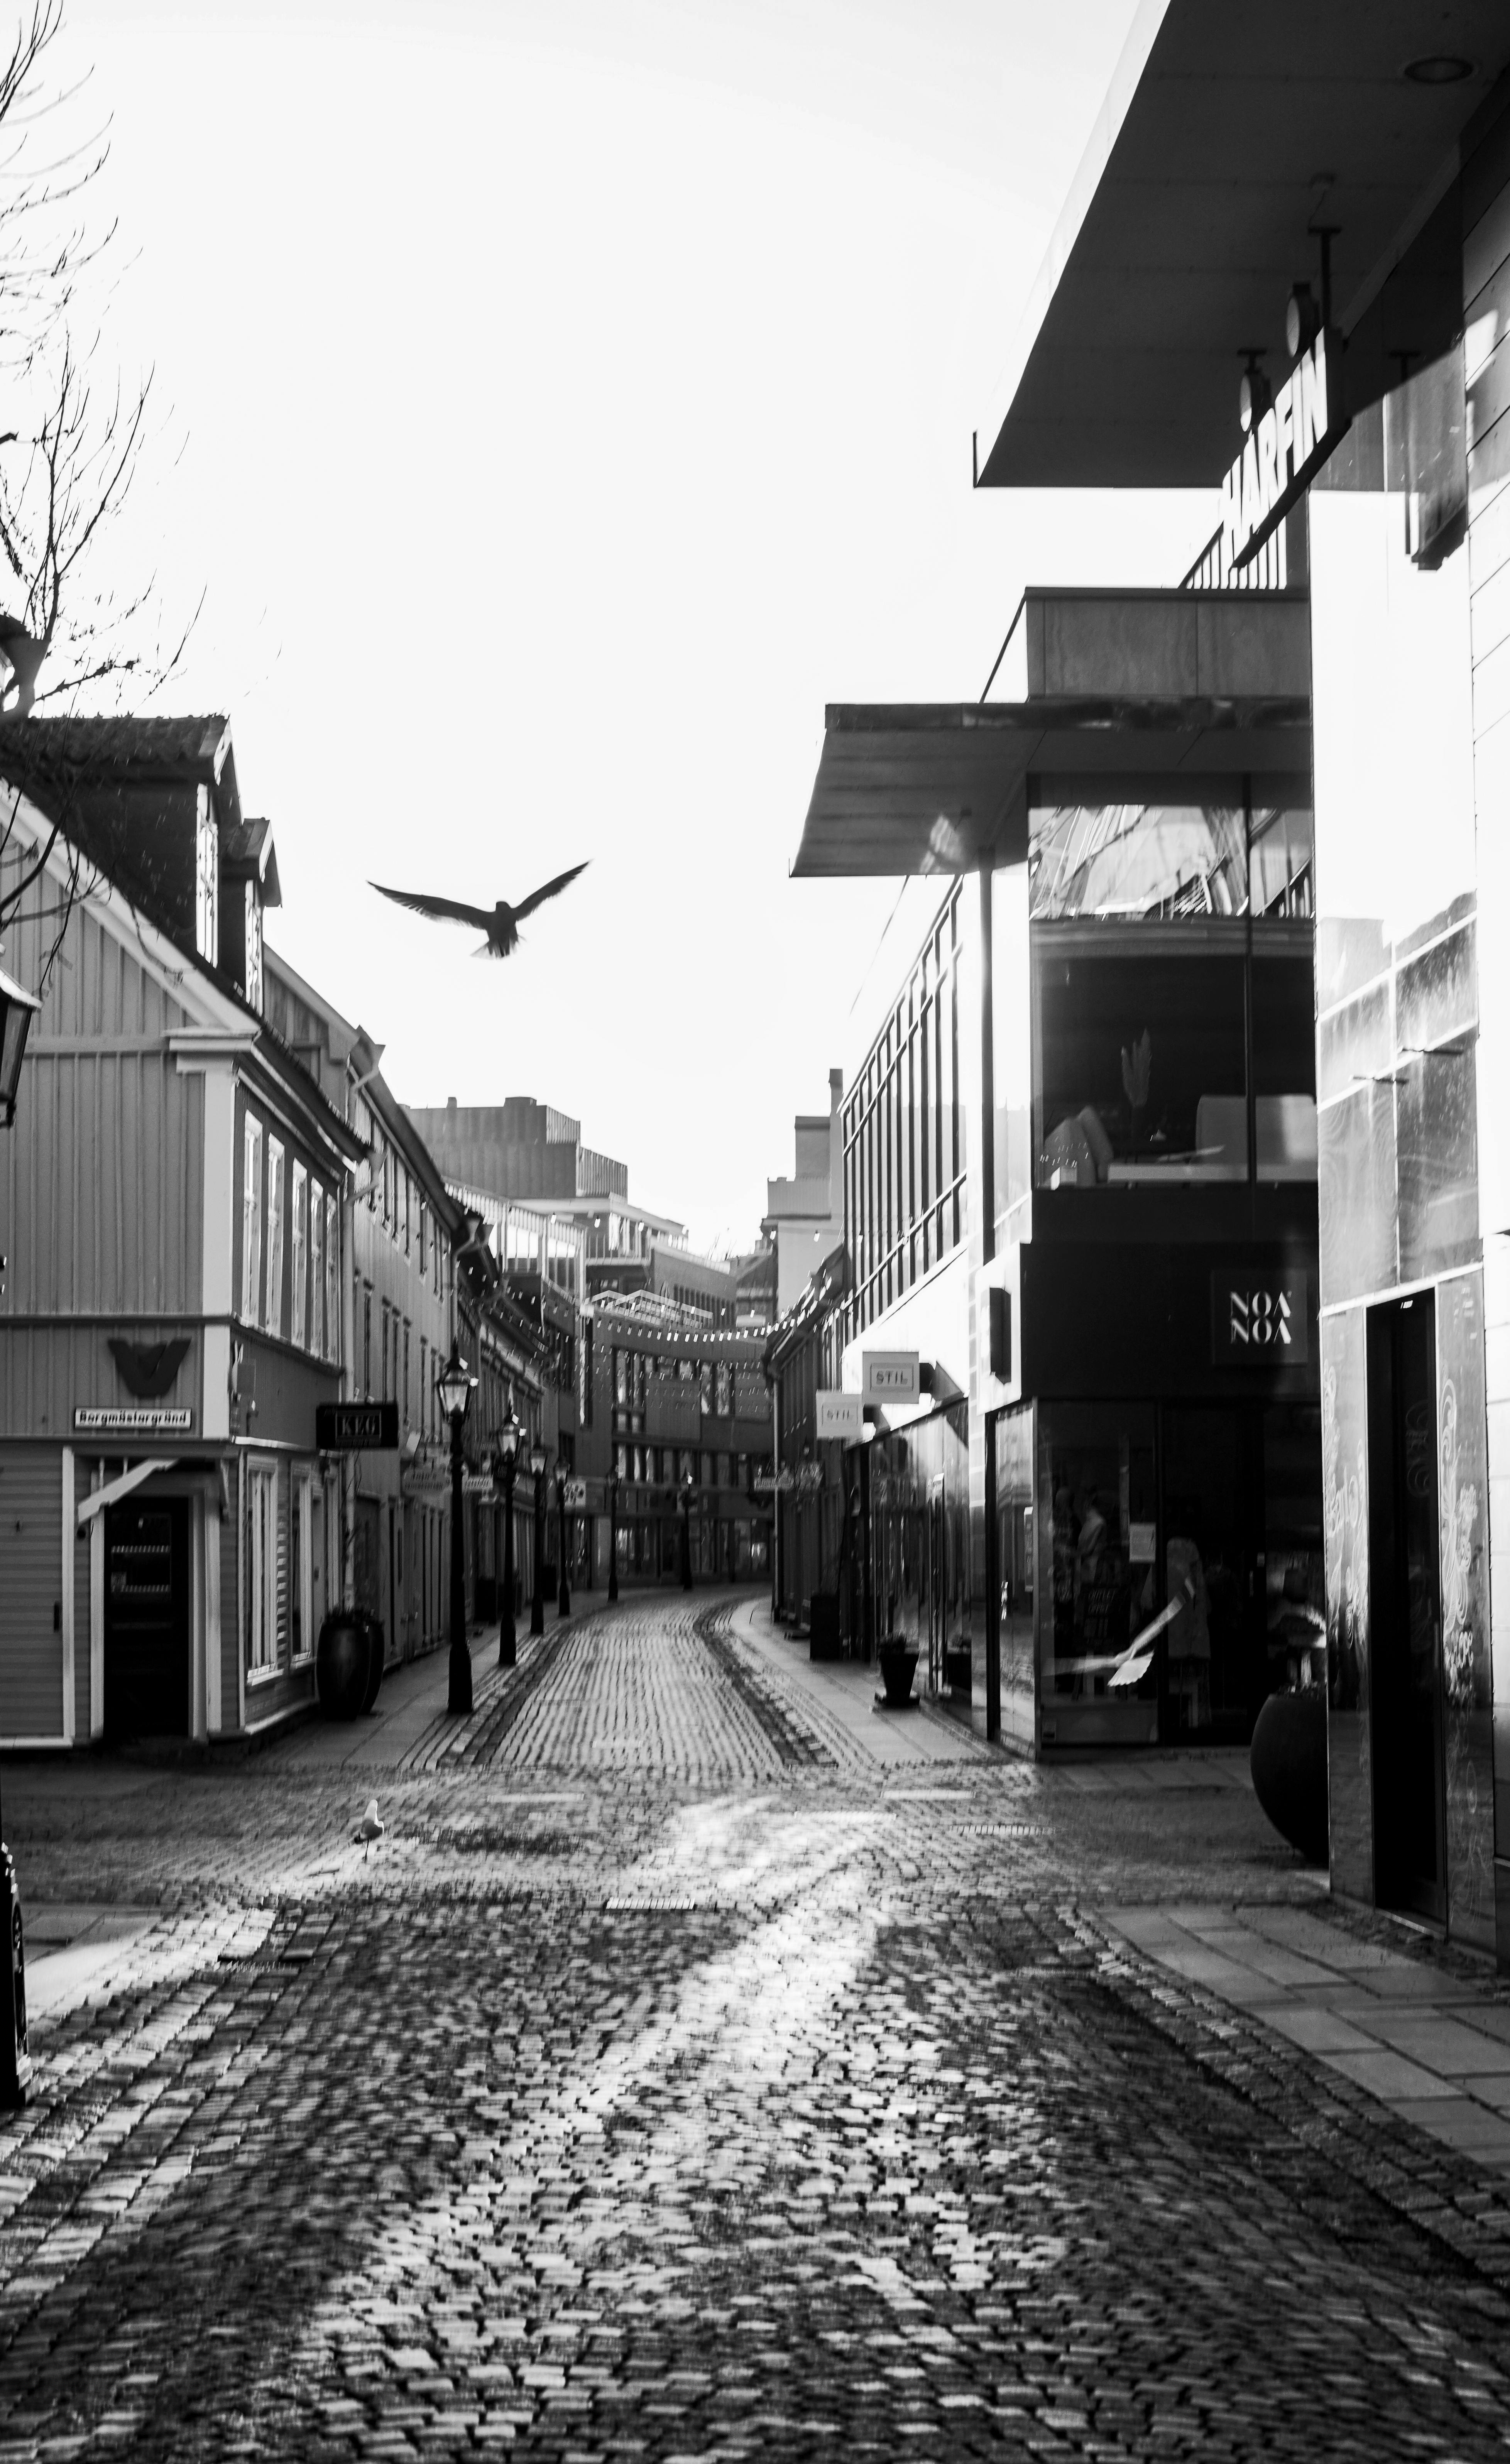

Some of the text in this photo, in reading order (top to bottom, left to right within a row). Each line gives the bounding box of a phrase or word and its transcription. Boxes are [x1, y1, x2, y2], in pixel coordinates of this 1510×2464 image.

[1230, 1291, 1291, 1318] NOA
[1230, 1318, 1291, 1344] NOA
[876, 1370, 908, 1385] STIL
